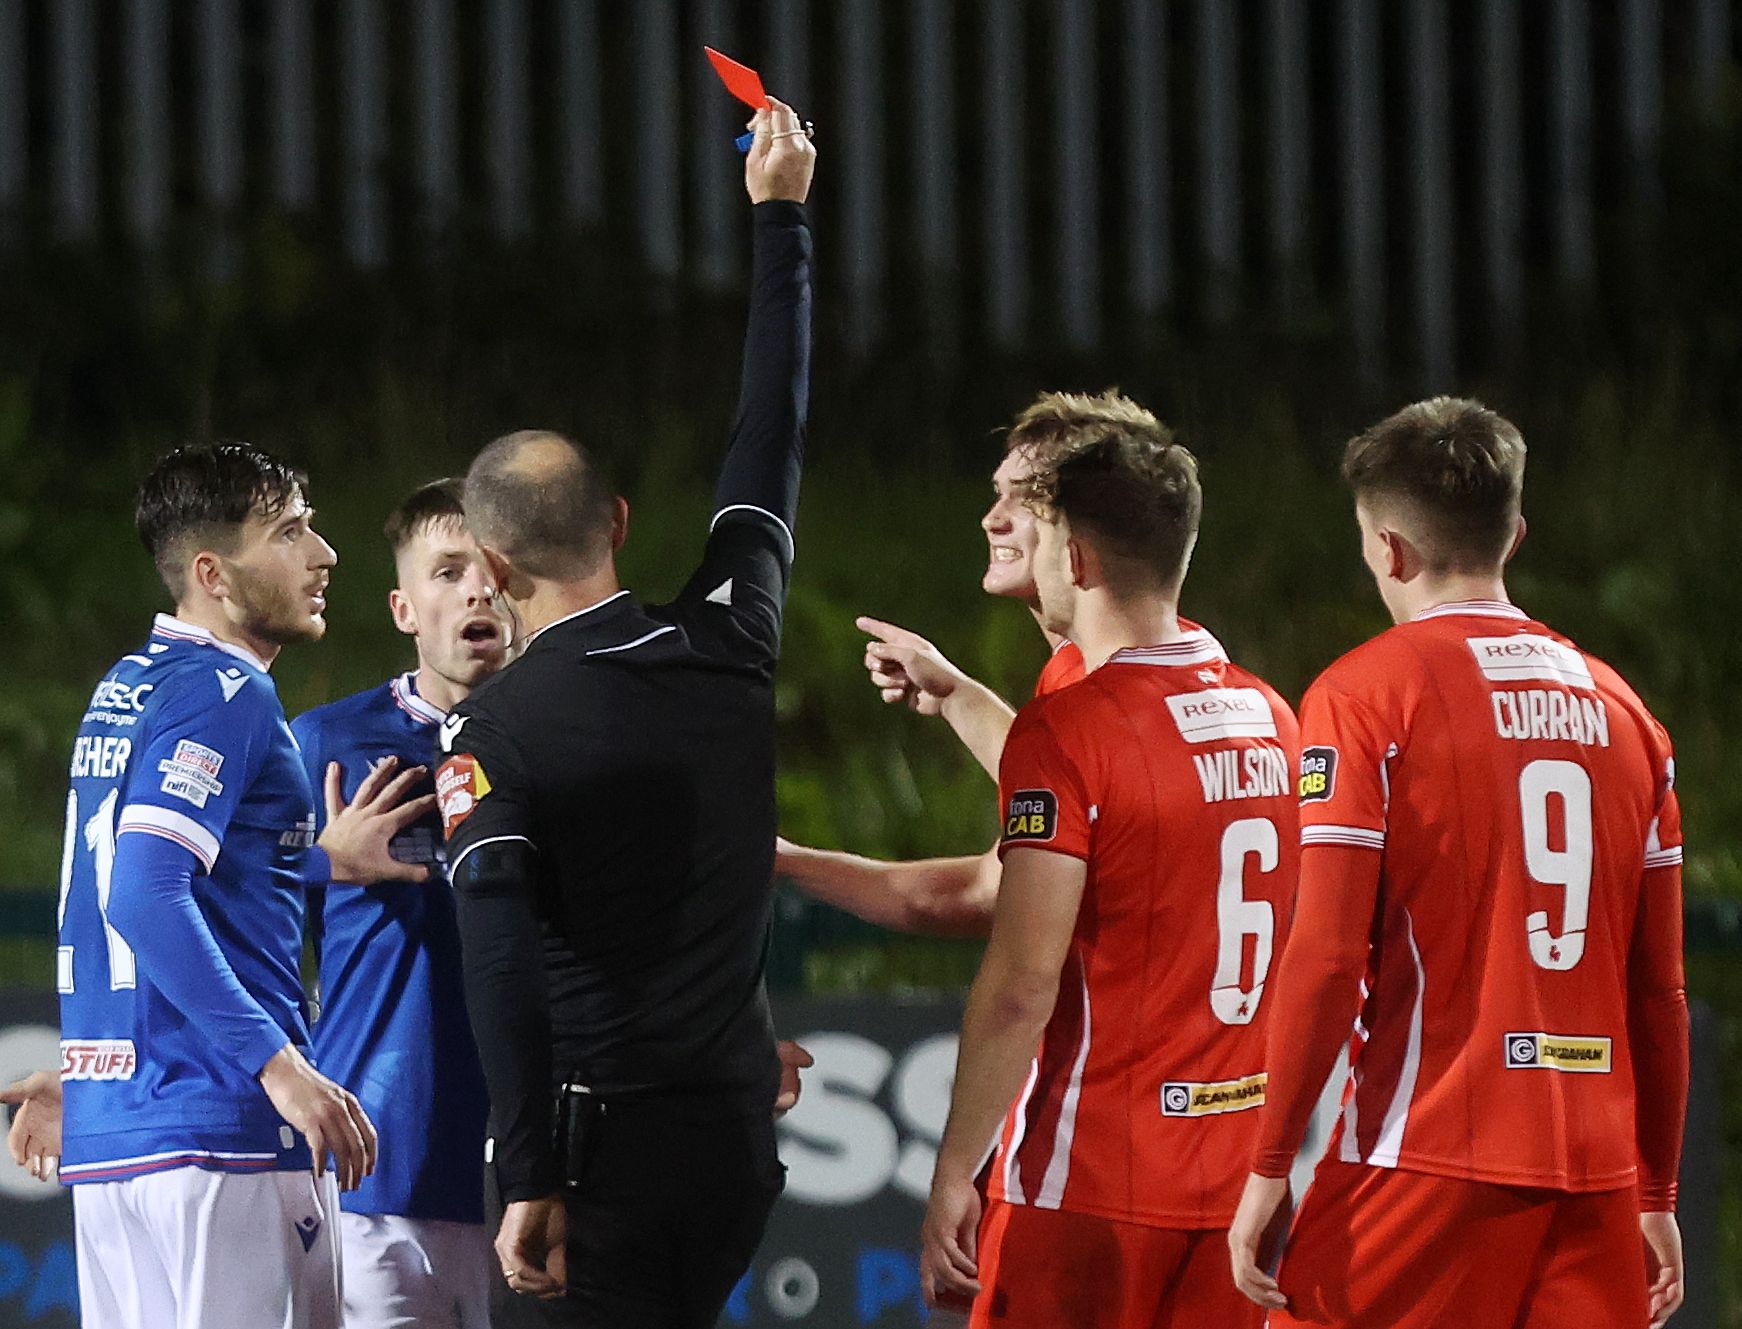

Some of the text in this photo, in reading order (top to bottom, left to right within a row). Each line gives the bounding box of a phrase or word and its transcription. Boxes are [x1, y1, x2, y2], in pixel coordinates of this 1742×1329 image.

[1491, 689, 1610, 748] CURRAN
[1192, 747, 1290, 803] WILSON
[1007, 815, 1045, 836] CAB
[1519, 759, 1593, 971] 9
[1210, 817, 1279, 1024] 6
